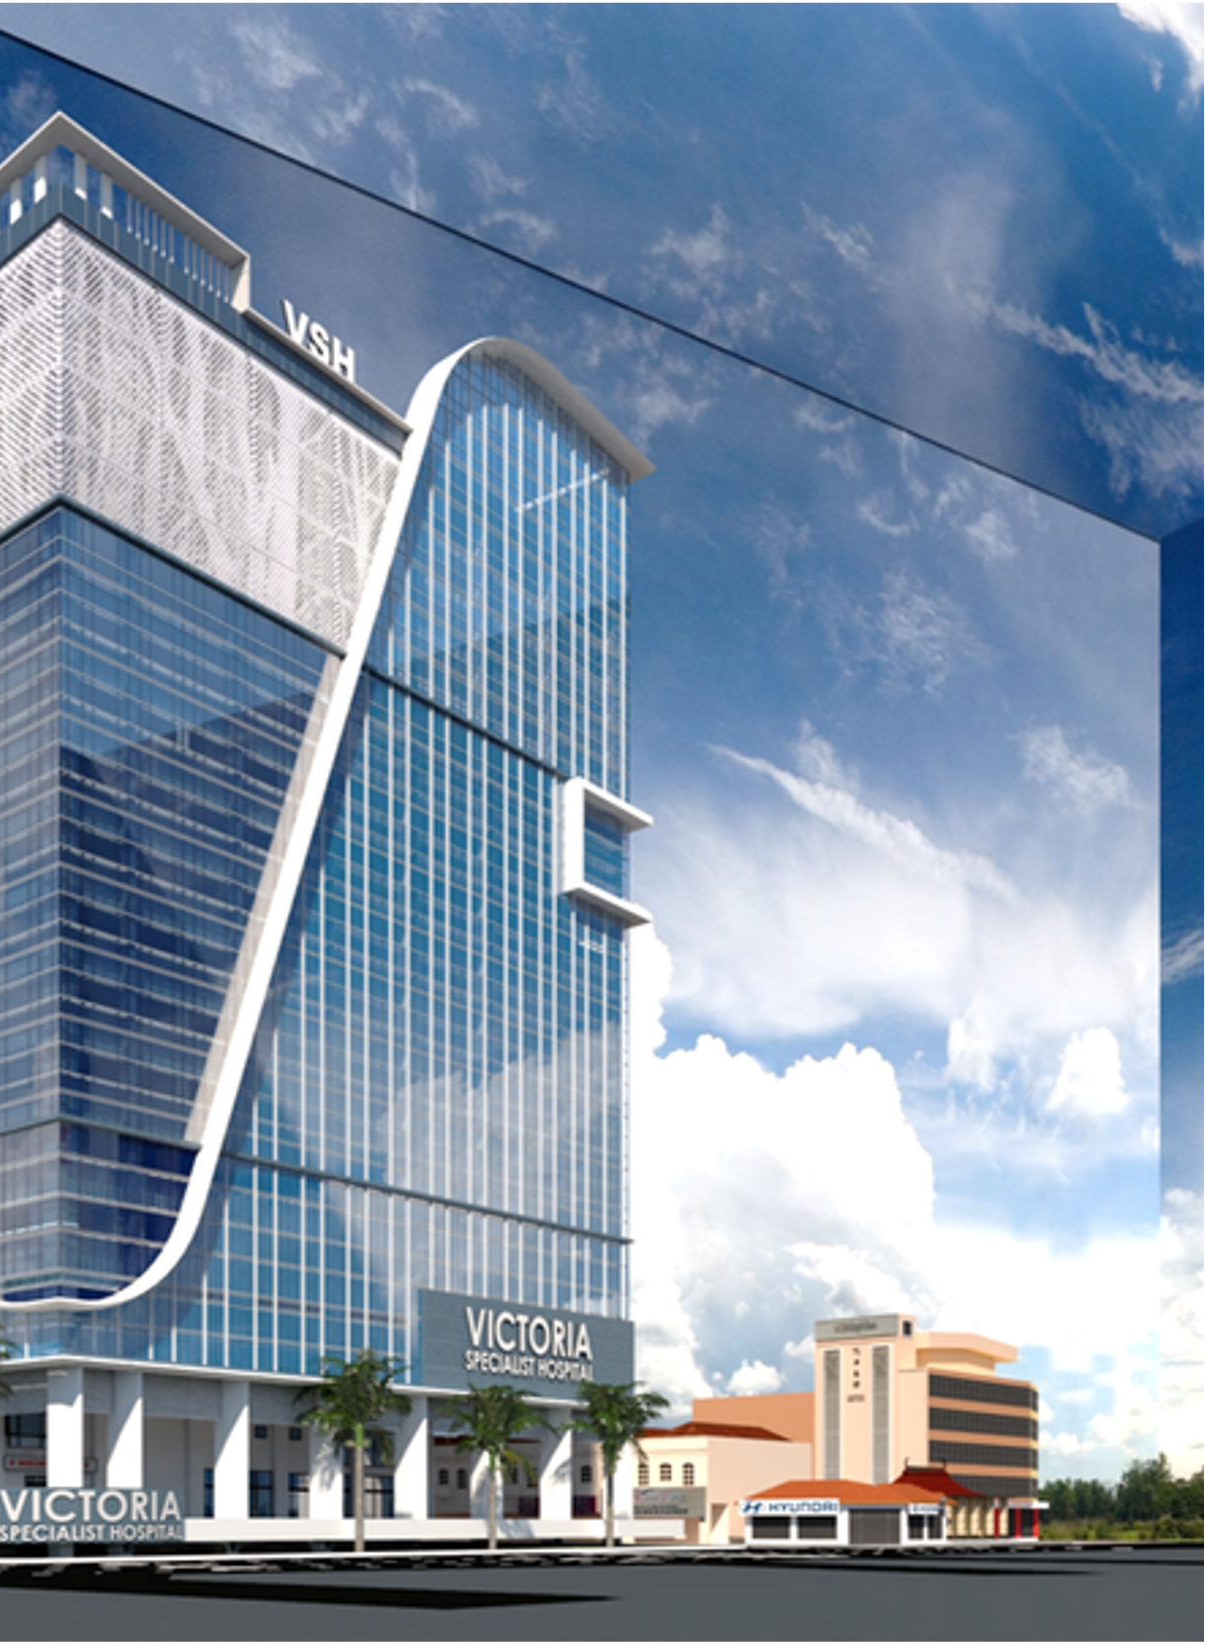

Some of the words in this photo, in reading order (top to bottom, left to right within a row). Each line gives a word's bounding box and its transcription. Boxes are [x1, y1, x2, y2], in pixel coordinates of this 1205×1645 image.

[280, 299, 356, 384] VSH
[466, 1306, 593, 1360] VICTORIA
[465, 1349, 534, 1376] SPECIALIST
[537, 1359, 594, 1382] HOSPITAL
[0, 1489, 181, 1522] VICTORIA
[769, 1502, 838, 1513] HYUNDAI
[0, 1525, 104, 1542] SPECIALIST
[109, 1523, 183, 1541] HOSPITAL
